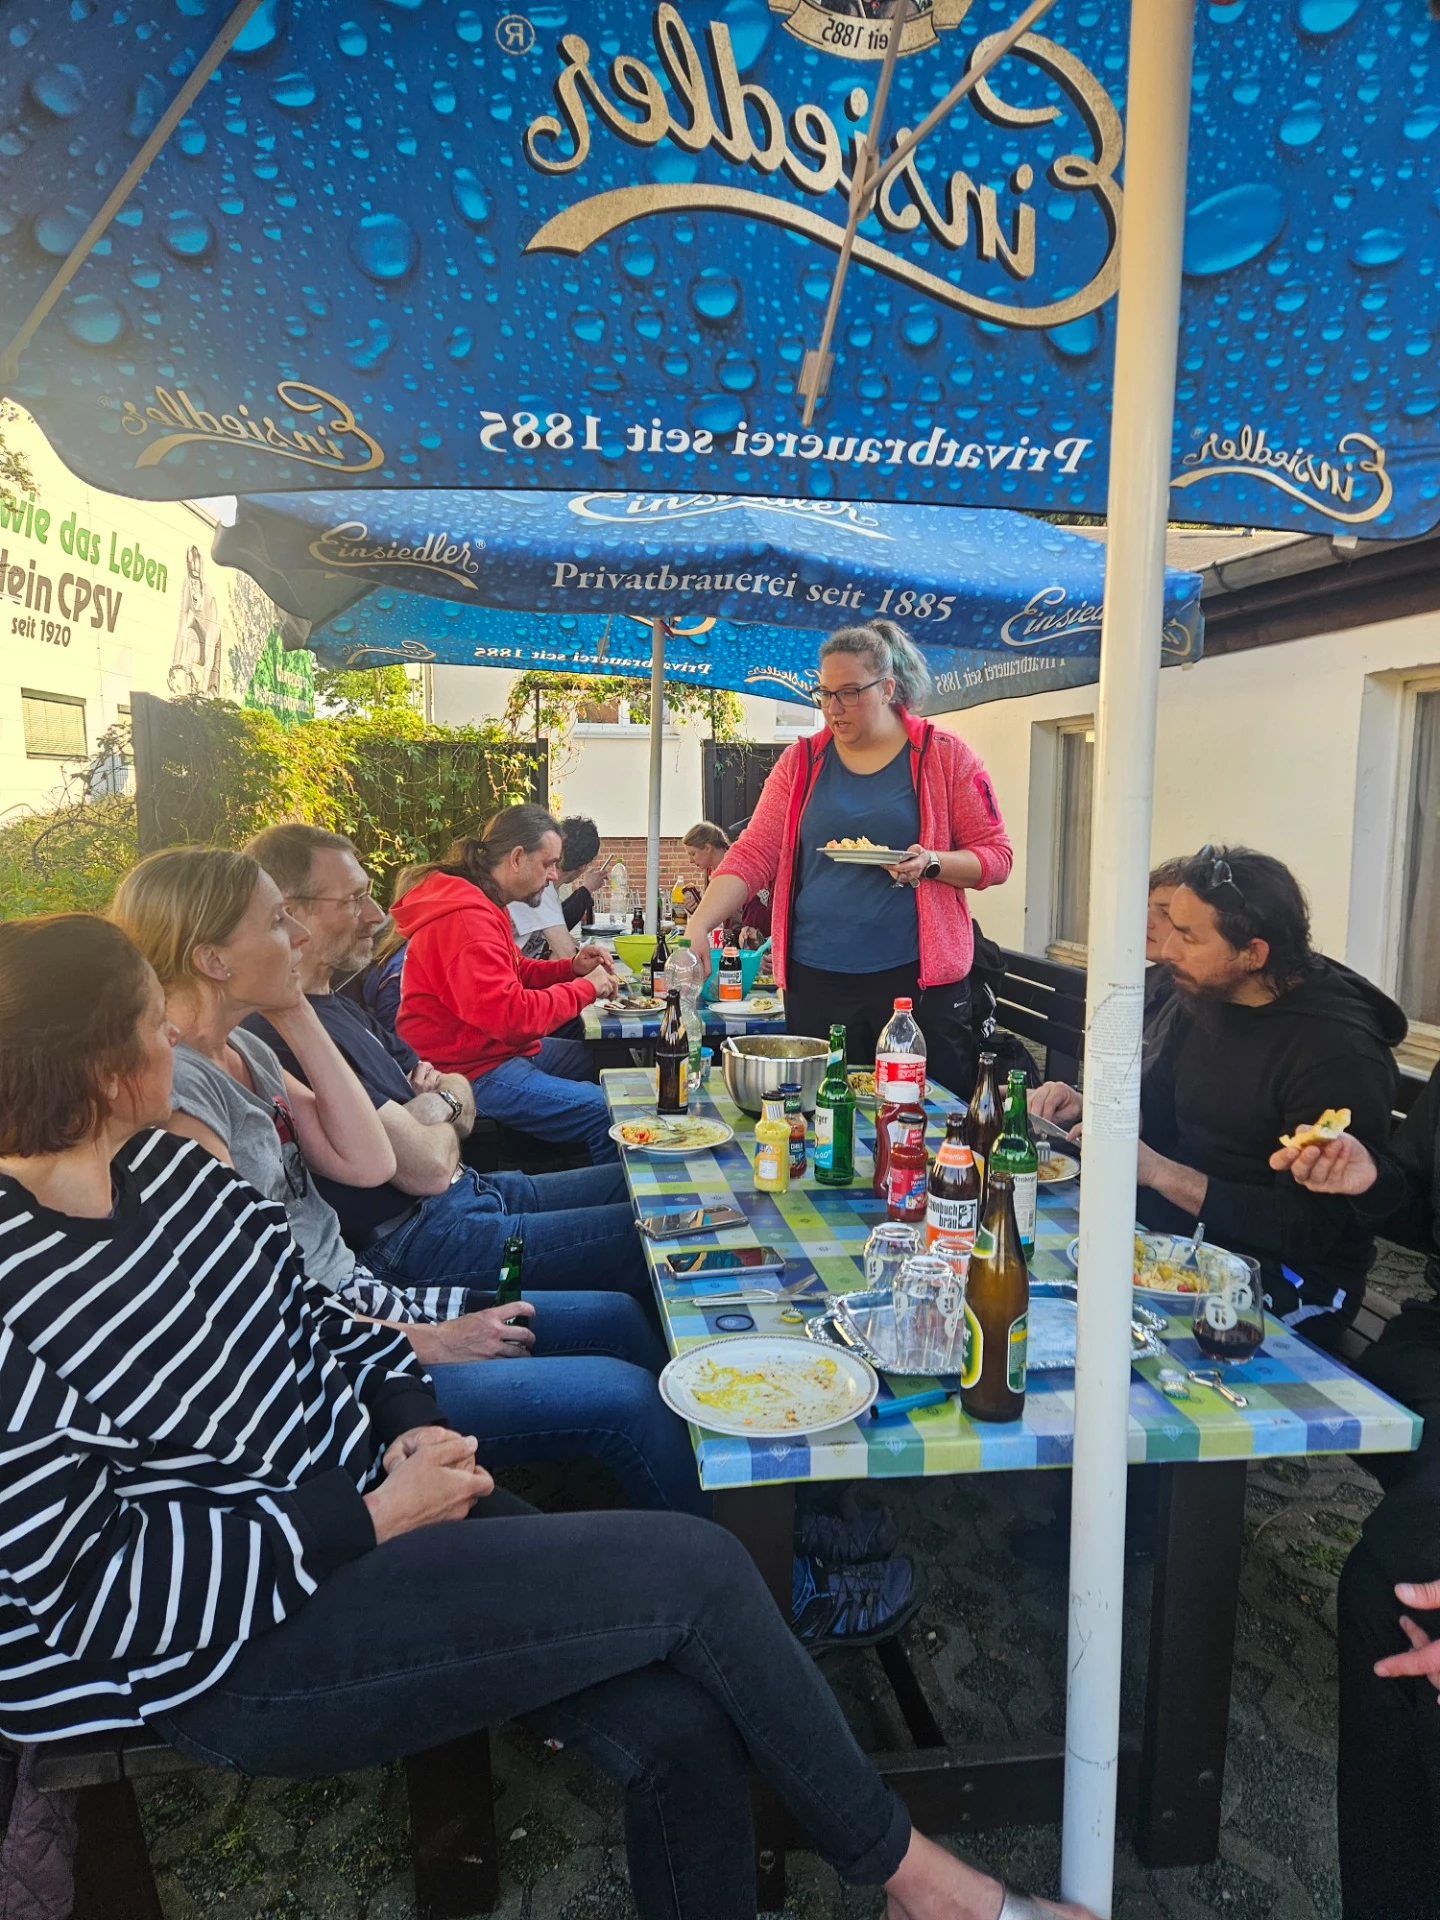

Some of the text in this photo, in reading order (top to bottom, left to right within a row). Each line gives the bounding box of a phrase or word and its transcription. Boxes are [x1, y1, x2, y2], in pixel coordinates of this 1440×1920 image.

[59, 511, 101, 565] das
[109, 531, 168, 593] Leben
[309, 521, 479, 590] Einsiedler
[58, 572, 123, 633] CPSV
[551, 562, 957, 622] Privatbrauerei seit 1885
[11, 615, 71, 648] seit 1920
